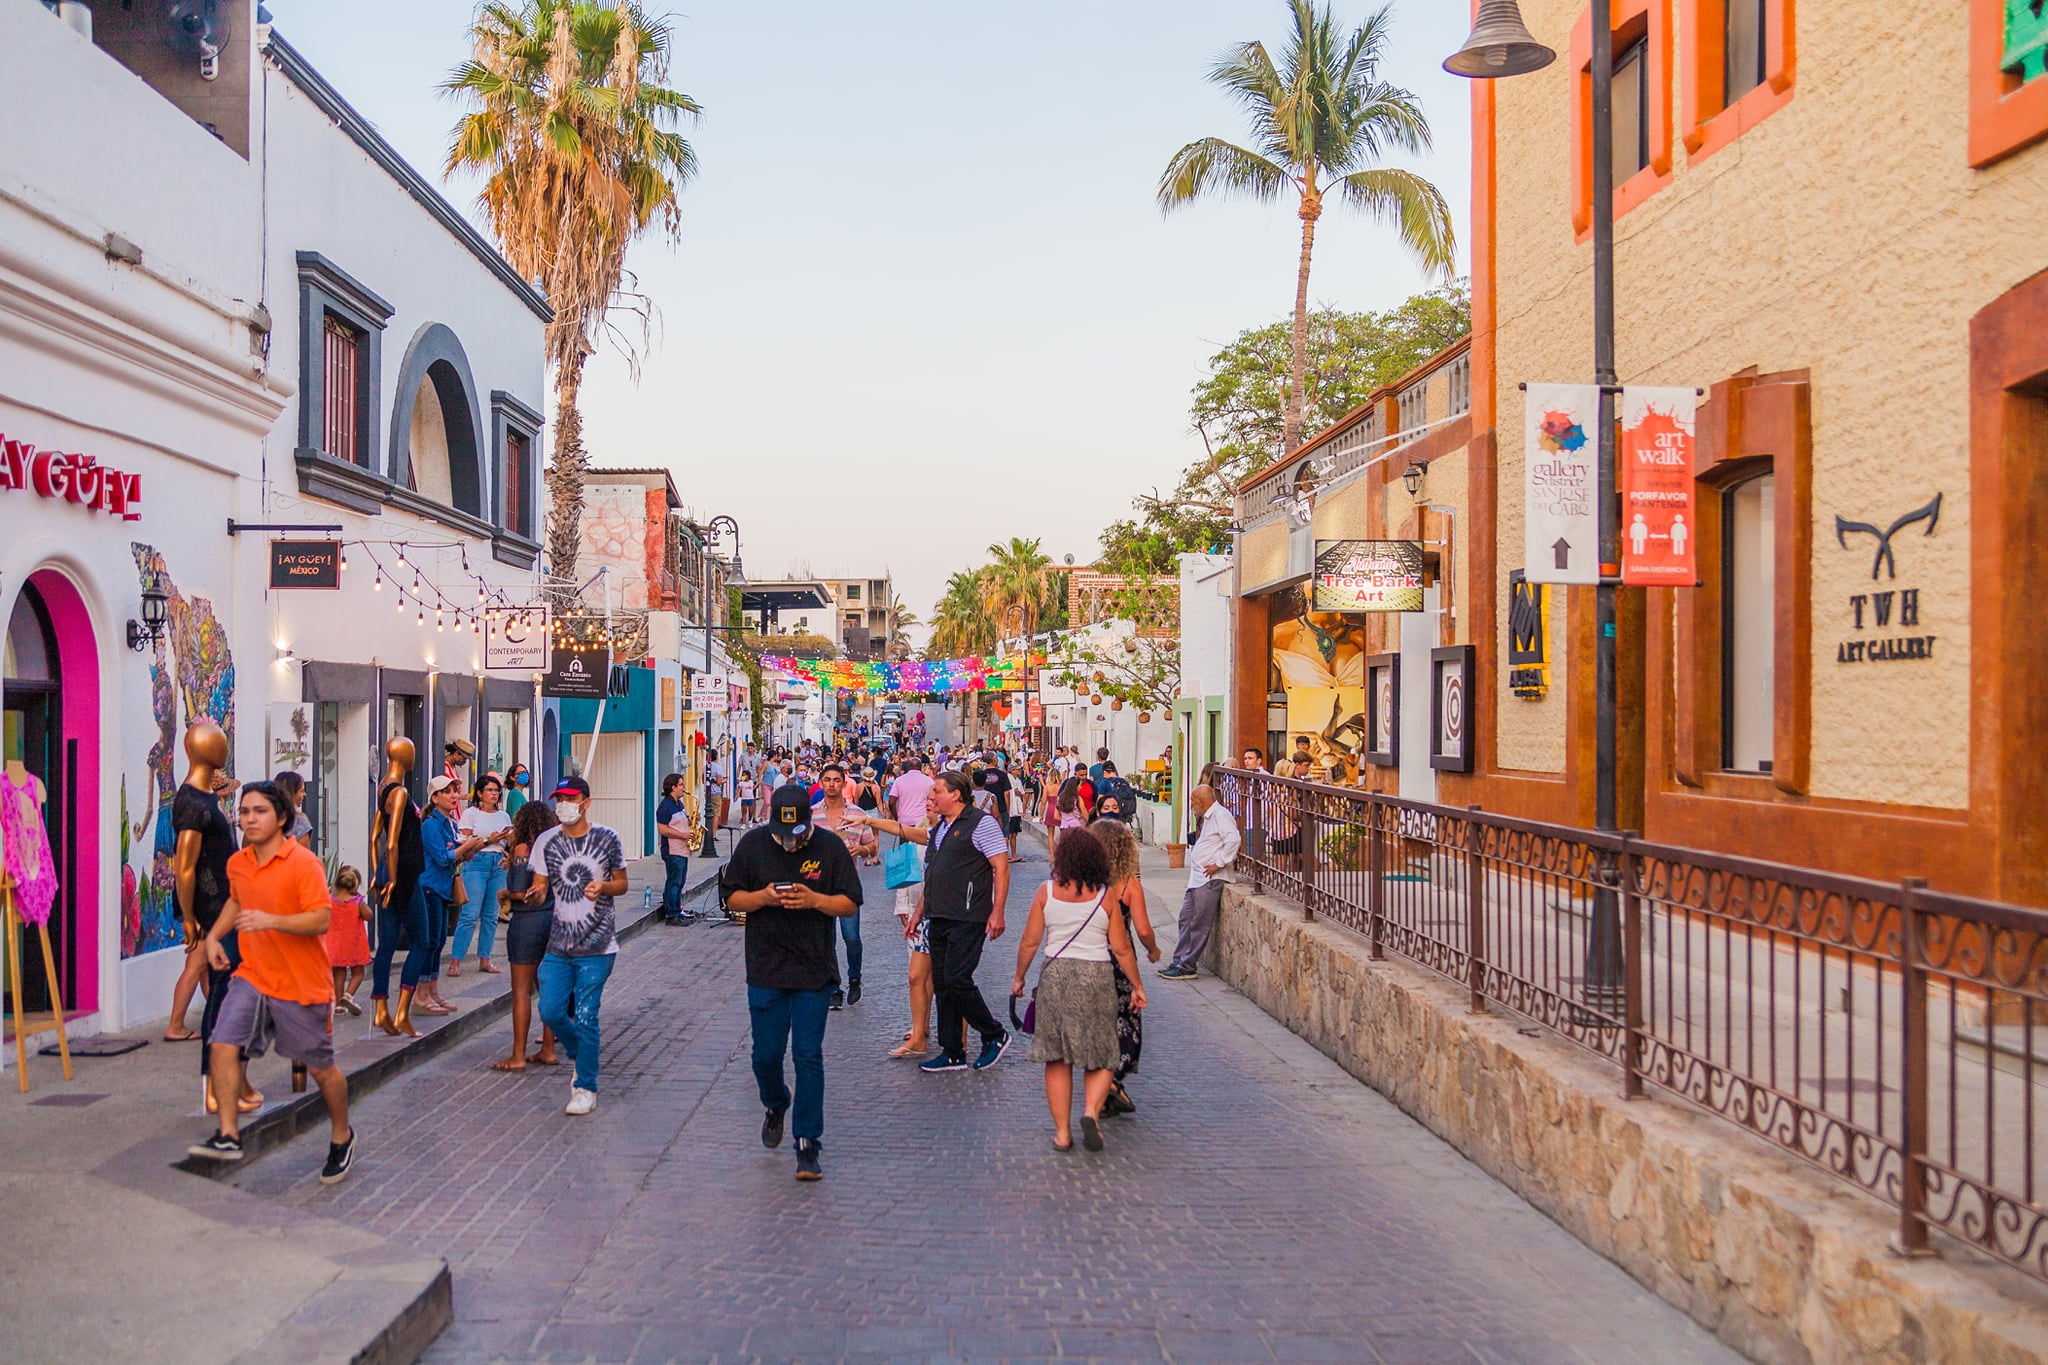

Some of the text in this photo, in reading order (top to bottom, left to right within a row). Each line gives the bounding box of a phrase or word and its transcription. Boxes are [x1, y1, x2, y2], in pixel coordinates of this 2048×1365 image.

[1654, 432, 1686, 448] art
[1636, 447, 1687, 466] walk
[1532, 460, 1590, 486] gallery
[1544, 477, 1581, 487] district
[1533, 487, 1590, 503] SAN JOSE
[1549, 502, 1590, 517] CABO
[1630, 500, 1688, 509] MANTENGA
[289, 565, 320, 576] MÉXICO
[1342, 556, 1399, 573] Authentic
[1322, 575, 1417, 588] Tree Bark
[1355, 589, 1385, 602] Art
[488, 647, 543, 656] CONTEMPORARY
[1837, 635, 1937, 663] ART GALLERY
[507, 657, 524, 665] ART
[697, 679, 722, 688] E P
